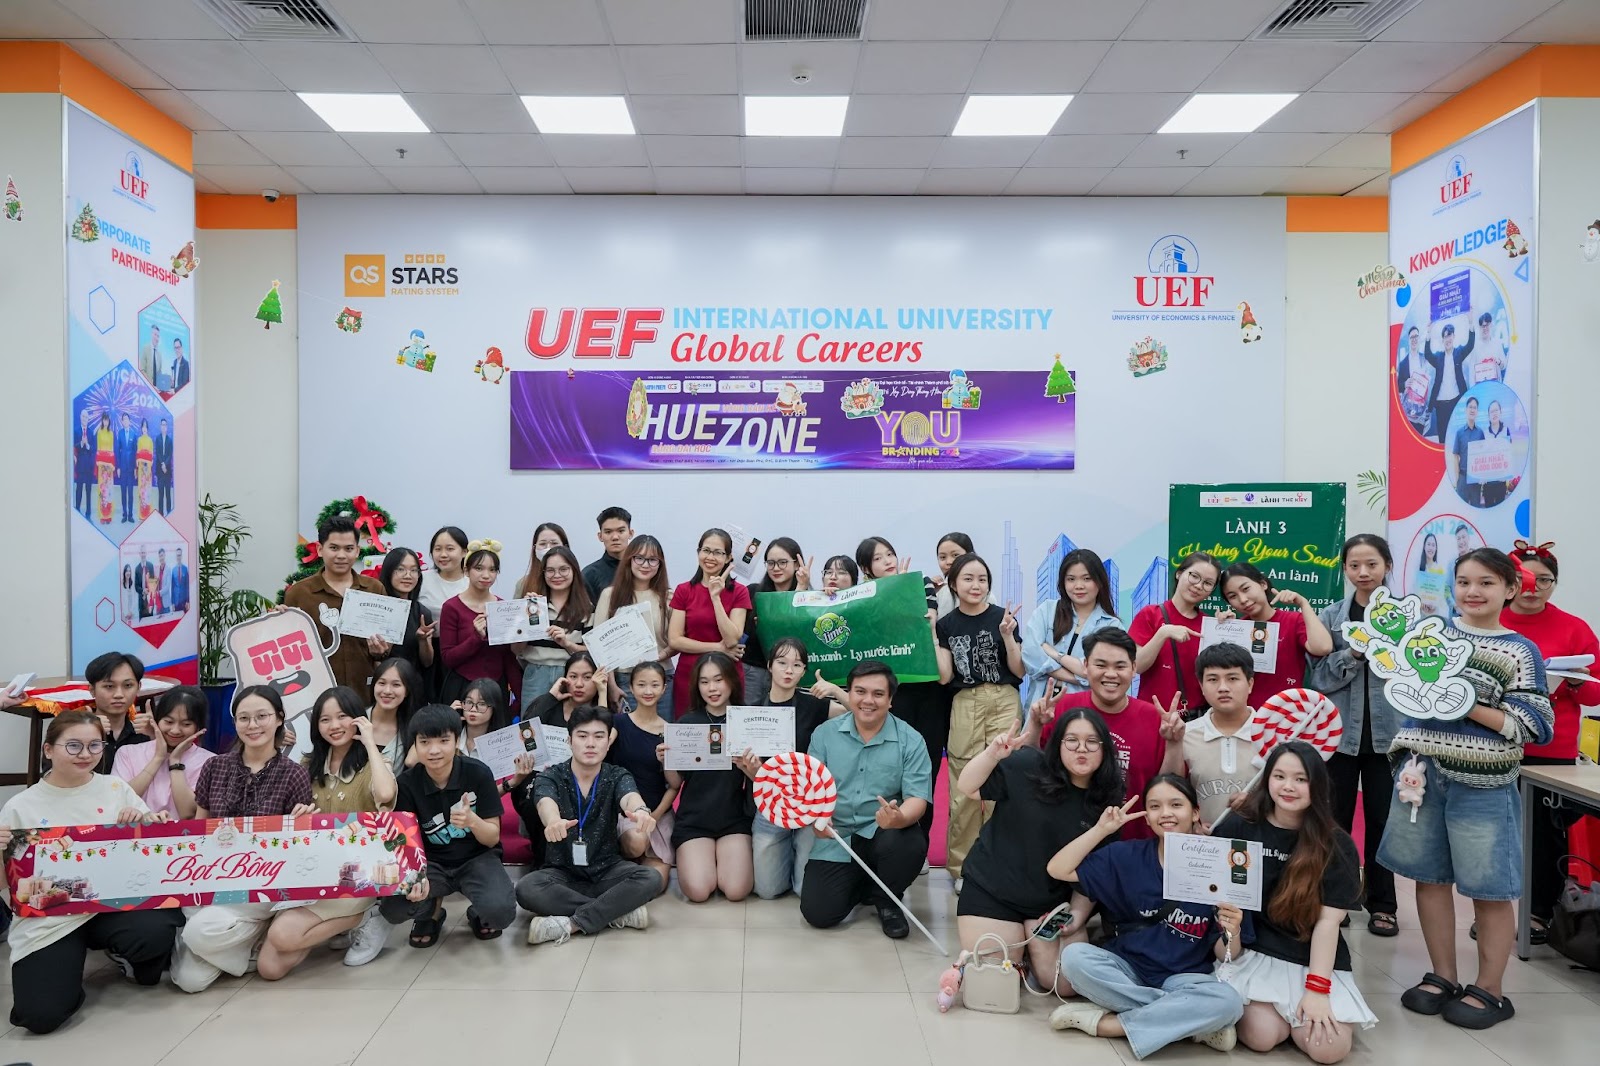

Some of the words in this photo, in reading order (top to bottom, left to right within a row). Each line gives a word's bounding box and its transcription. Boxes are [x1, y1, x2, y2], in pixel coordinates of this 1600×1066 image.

[119, 168, 150, 200] UEF
[1439, 172, 1473, 204] UEF
[1409, 217, 1508, 274] KNOWLEDGE
[111, 247, 180, 287] PARTNERSHIP
[350, 265, 380, 286] QS
[391, 267, 459, 285] STARS
[391, 287, 424, 296] RATING
[426, 287, 459, 296] SYSTEM
[1133, 276, 1215, 307] UEF
[673, 307, 888, 330] INTERNATIONAL
[898, 308, 1053, 330] UNIVERSITY
[1112, 314, 1150, 322] UNIVERSITY
[1151, 314, 1160, 322] OF
[1161, 314, 1200, 322] ECONOMICS
[1207, 314, 1236, 322] FINANCE
[525, 307, 664, 360] UEF
[670, 332, 784, 363] Global
[796, 333, 923, 363] Careers
[639, 403, 721, 441] HUE
[715, 416, 822, 455] ZONE
[874, 410, 961, 447] YOU
[882, 446, 940, 458] BRANDING
[1225, 517, 1271, 535] LÀNH
[1278, 521, 1287, 535] 3
[1243, 537, 1290, 563] Your
[1293, 544, 1340, 568] Soul
[1268, 568, 1286, 580] An
[1289, 569, 1319, 584] lành
[359, 602, 394, 613] CERTIFICATE
[599, 622, 630, 642] CERTIFICATE
[820, 651, 842, 662] xanh
[850, 649, 863, 662] Ly
[743, 715, 779, 725] CERTIFICATE
[1181, 841, 1220, 855] Certificate
[160, 852, 223, 887] Bọt
[215, 850, 287, 887] Bông
